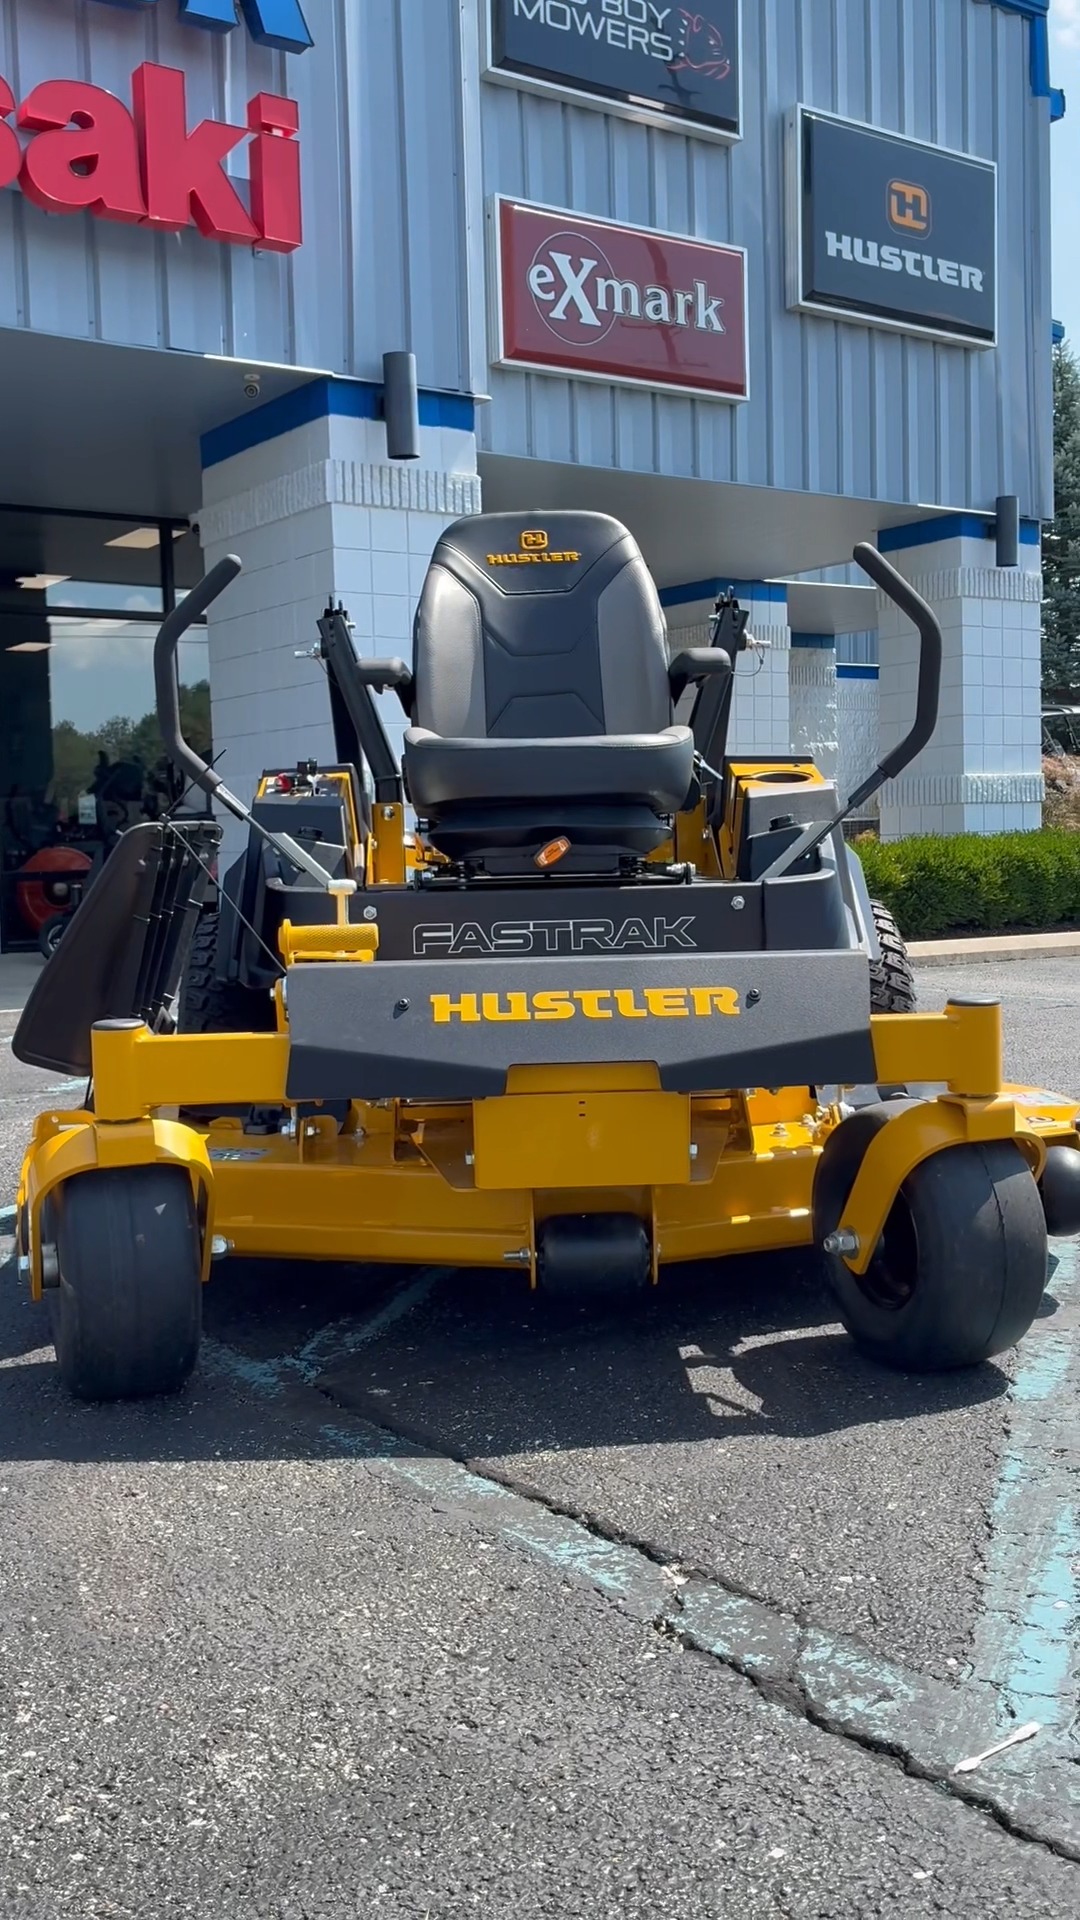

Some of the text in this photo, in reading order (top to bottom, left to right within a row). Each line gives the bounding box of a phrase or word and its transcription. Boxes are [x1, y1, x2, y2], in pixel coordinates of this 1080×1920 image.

[513, 0, 673, 61] MOWERS
[0, 61, 302, 254] aki
[825, 230, 984, 292] HUSTLER
[527, 250, 726, 334] eXmark
[486, 551, 580, 565] HUSTLER
[413, 916, 697, 954] FASTRAK
[430, 986, 740, 1022] HUSTLER
